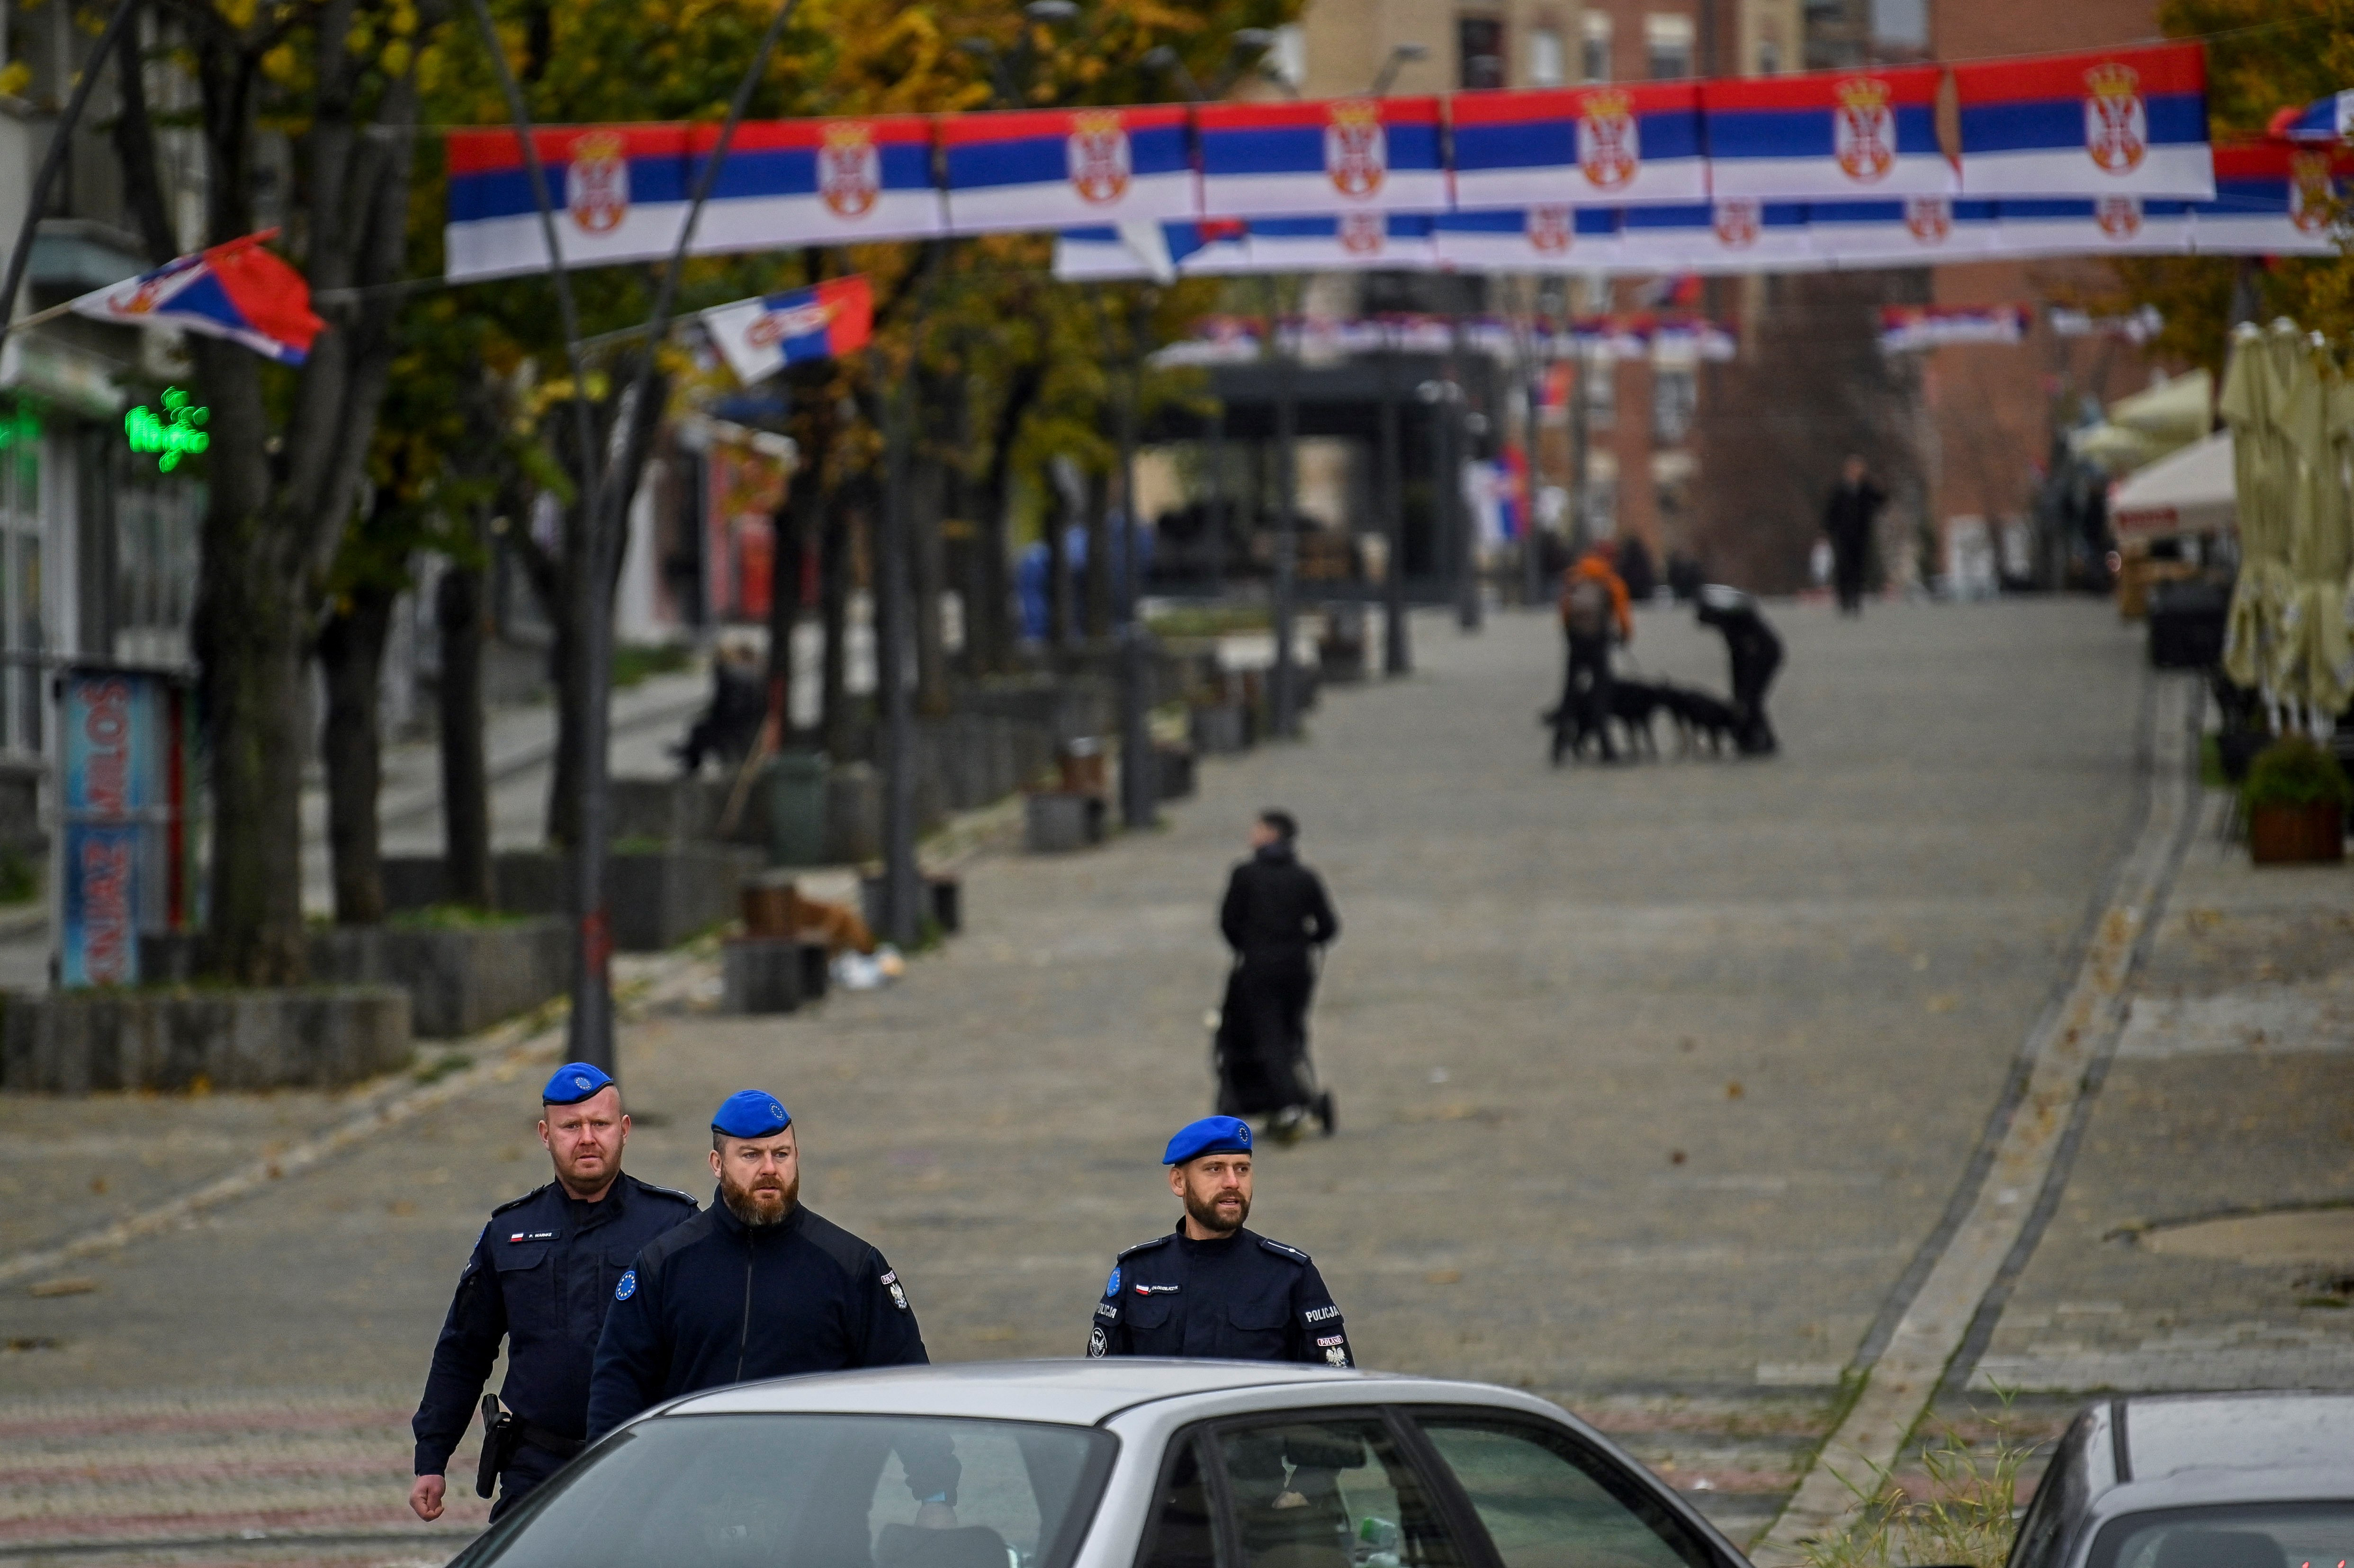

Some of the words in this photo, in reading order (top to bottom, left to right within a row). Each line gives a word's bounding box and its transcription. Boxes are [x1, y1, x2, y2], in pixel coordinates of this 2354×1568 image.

[1096, 1302, 1118, 1319] OLICJA
[1305, 1306, 1340, 1323] POLICJA
[1321, 1336, 1341, 1345] POLAND
